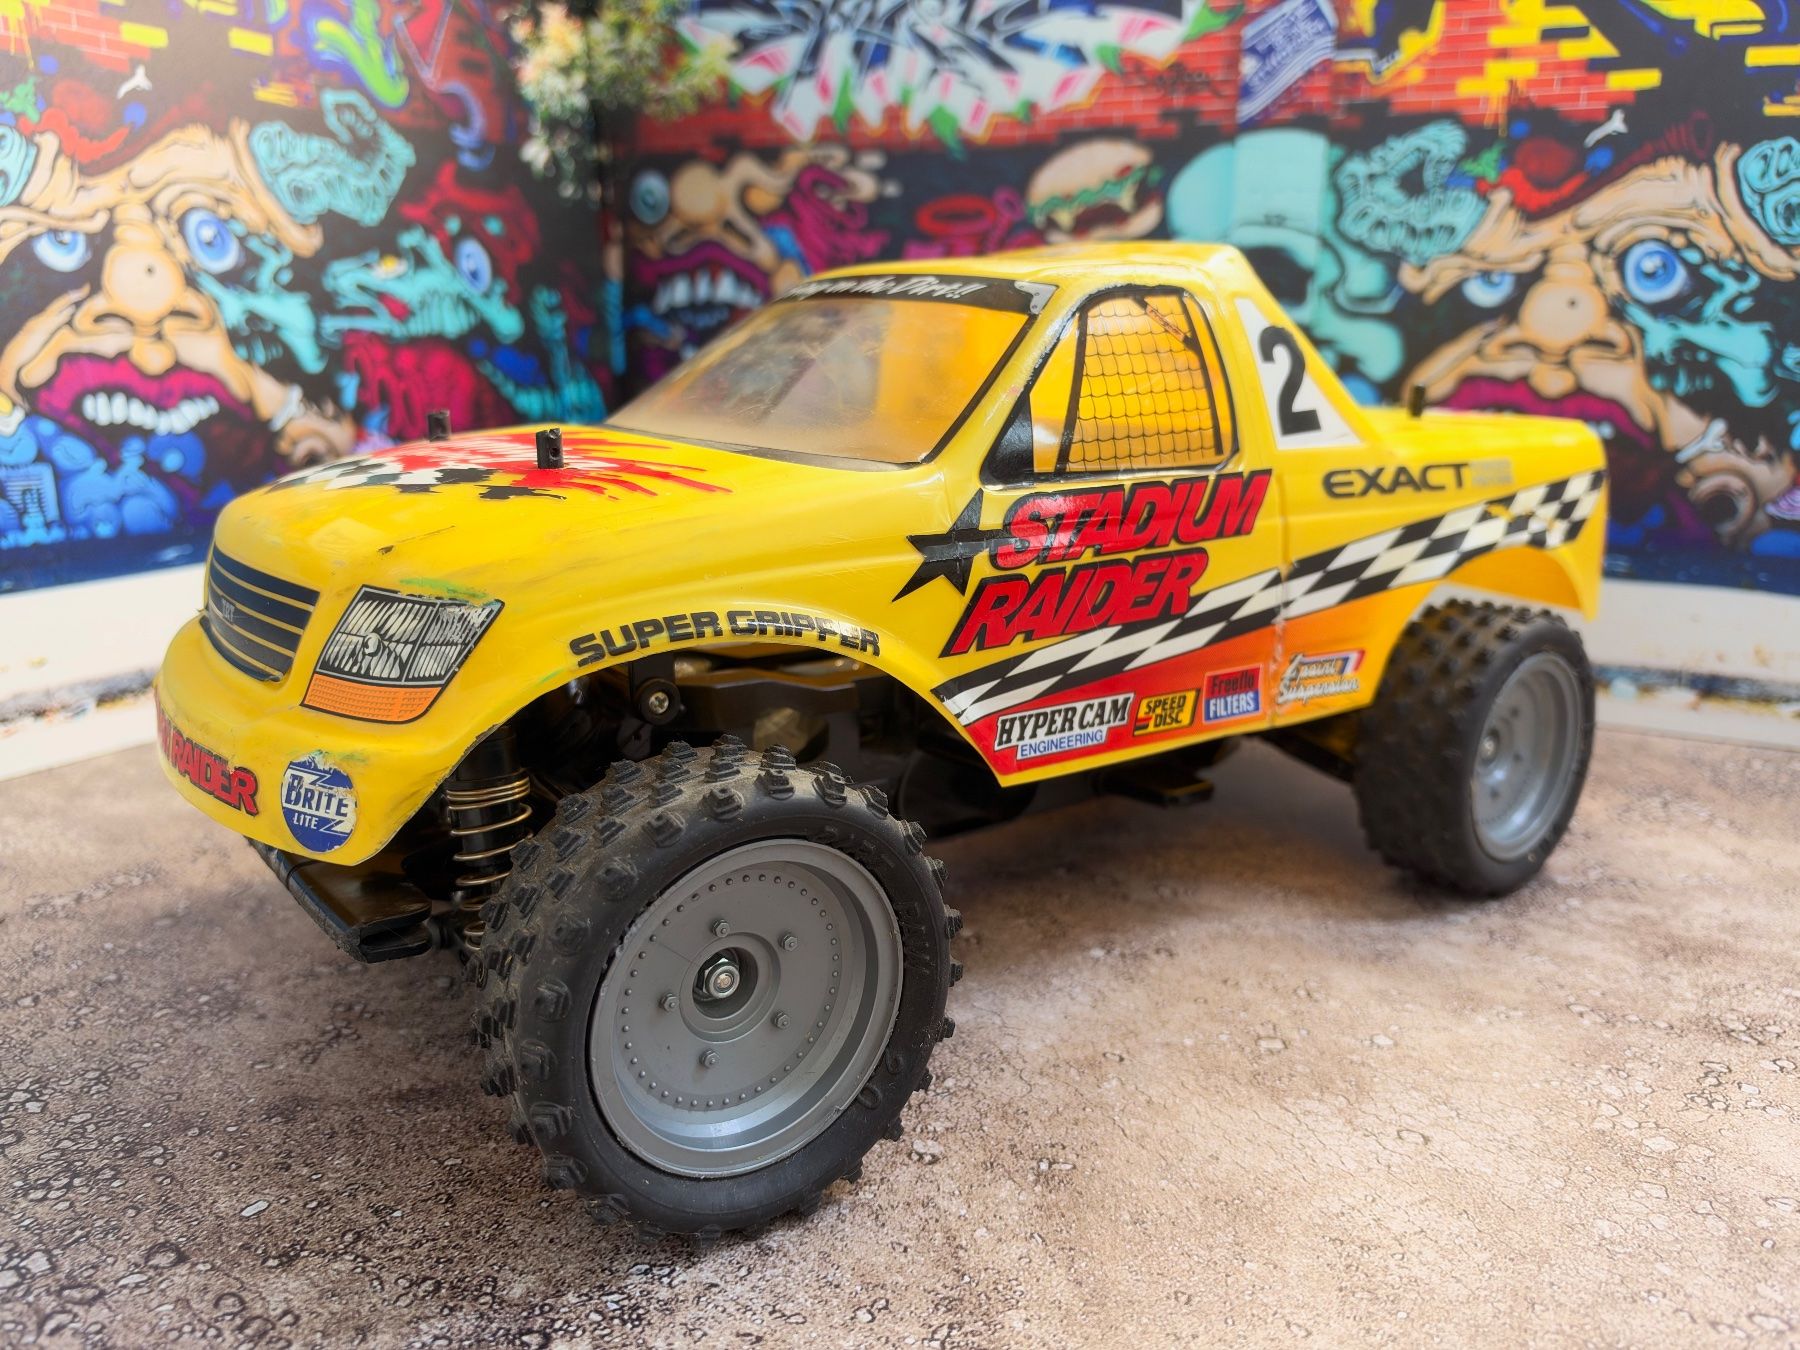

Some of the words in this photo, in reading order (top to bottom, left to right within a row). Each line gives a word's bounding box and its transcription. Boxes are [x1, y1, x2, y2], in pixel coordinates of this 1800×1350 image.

[1259, 325, 1322, 437] 2
[1322, 463, 1469, 499] EXACT
[990, 469, 1273, 570] STADIUM
[940, 547, 1209, 659] RAIDER
[569, 611, 724, 668] SUPER
[726, 609, 881, 658] GRIPPER
[996, 705, 1078, 748] HYPER
[1078, 696, 1132, 730] CAM
[1144, 694, 1187, 715] SPEED
[1153, 708, 1183, 728] DISC
[1209, 691, 1256, 720] FILTERS
[1019, 729, 1104, 758] ENGINEERING
[170, 725, 260, 818] RAIDER
[284, 773, 350, 818] BRITE
[293, 812, 320, 830] LITE
